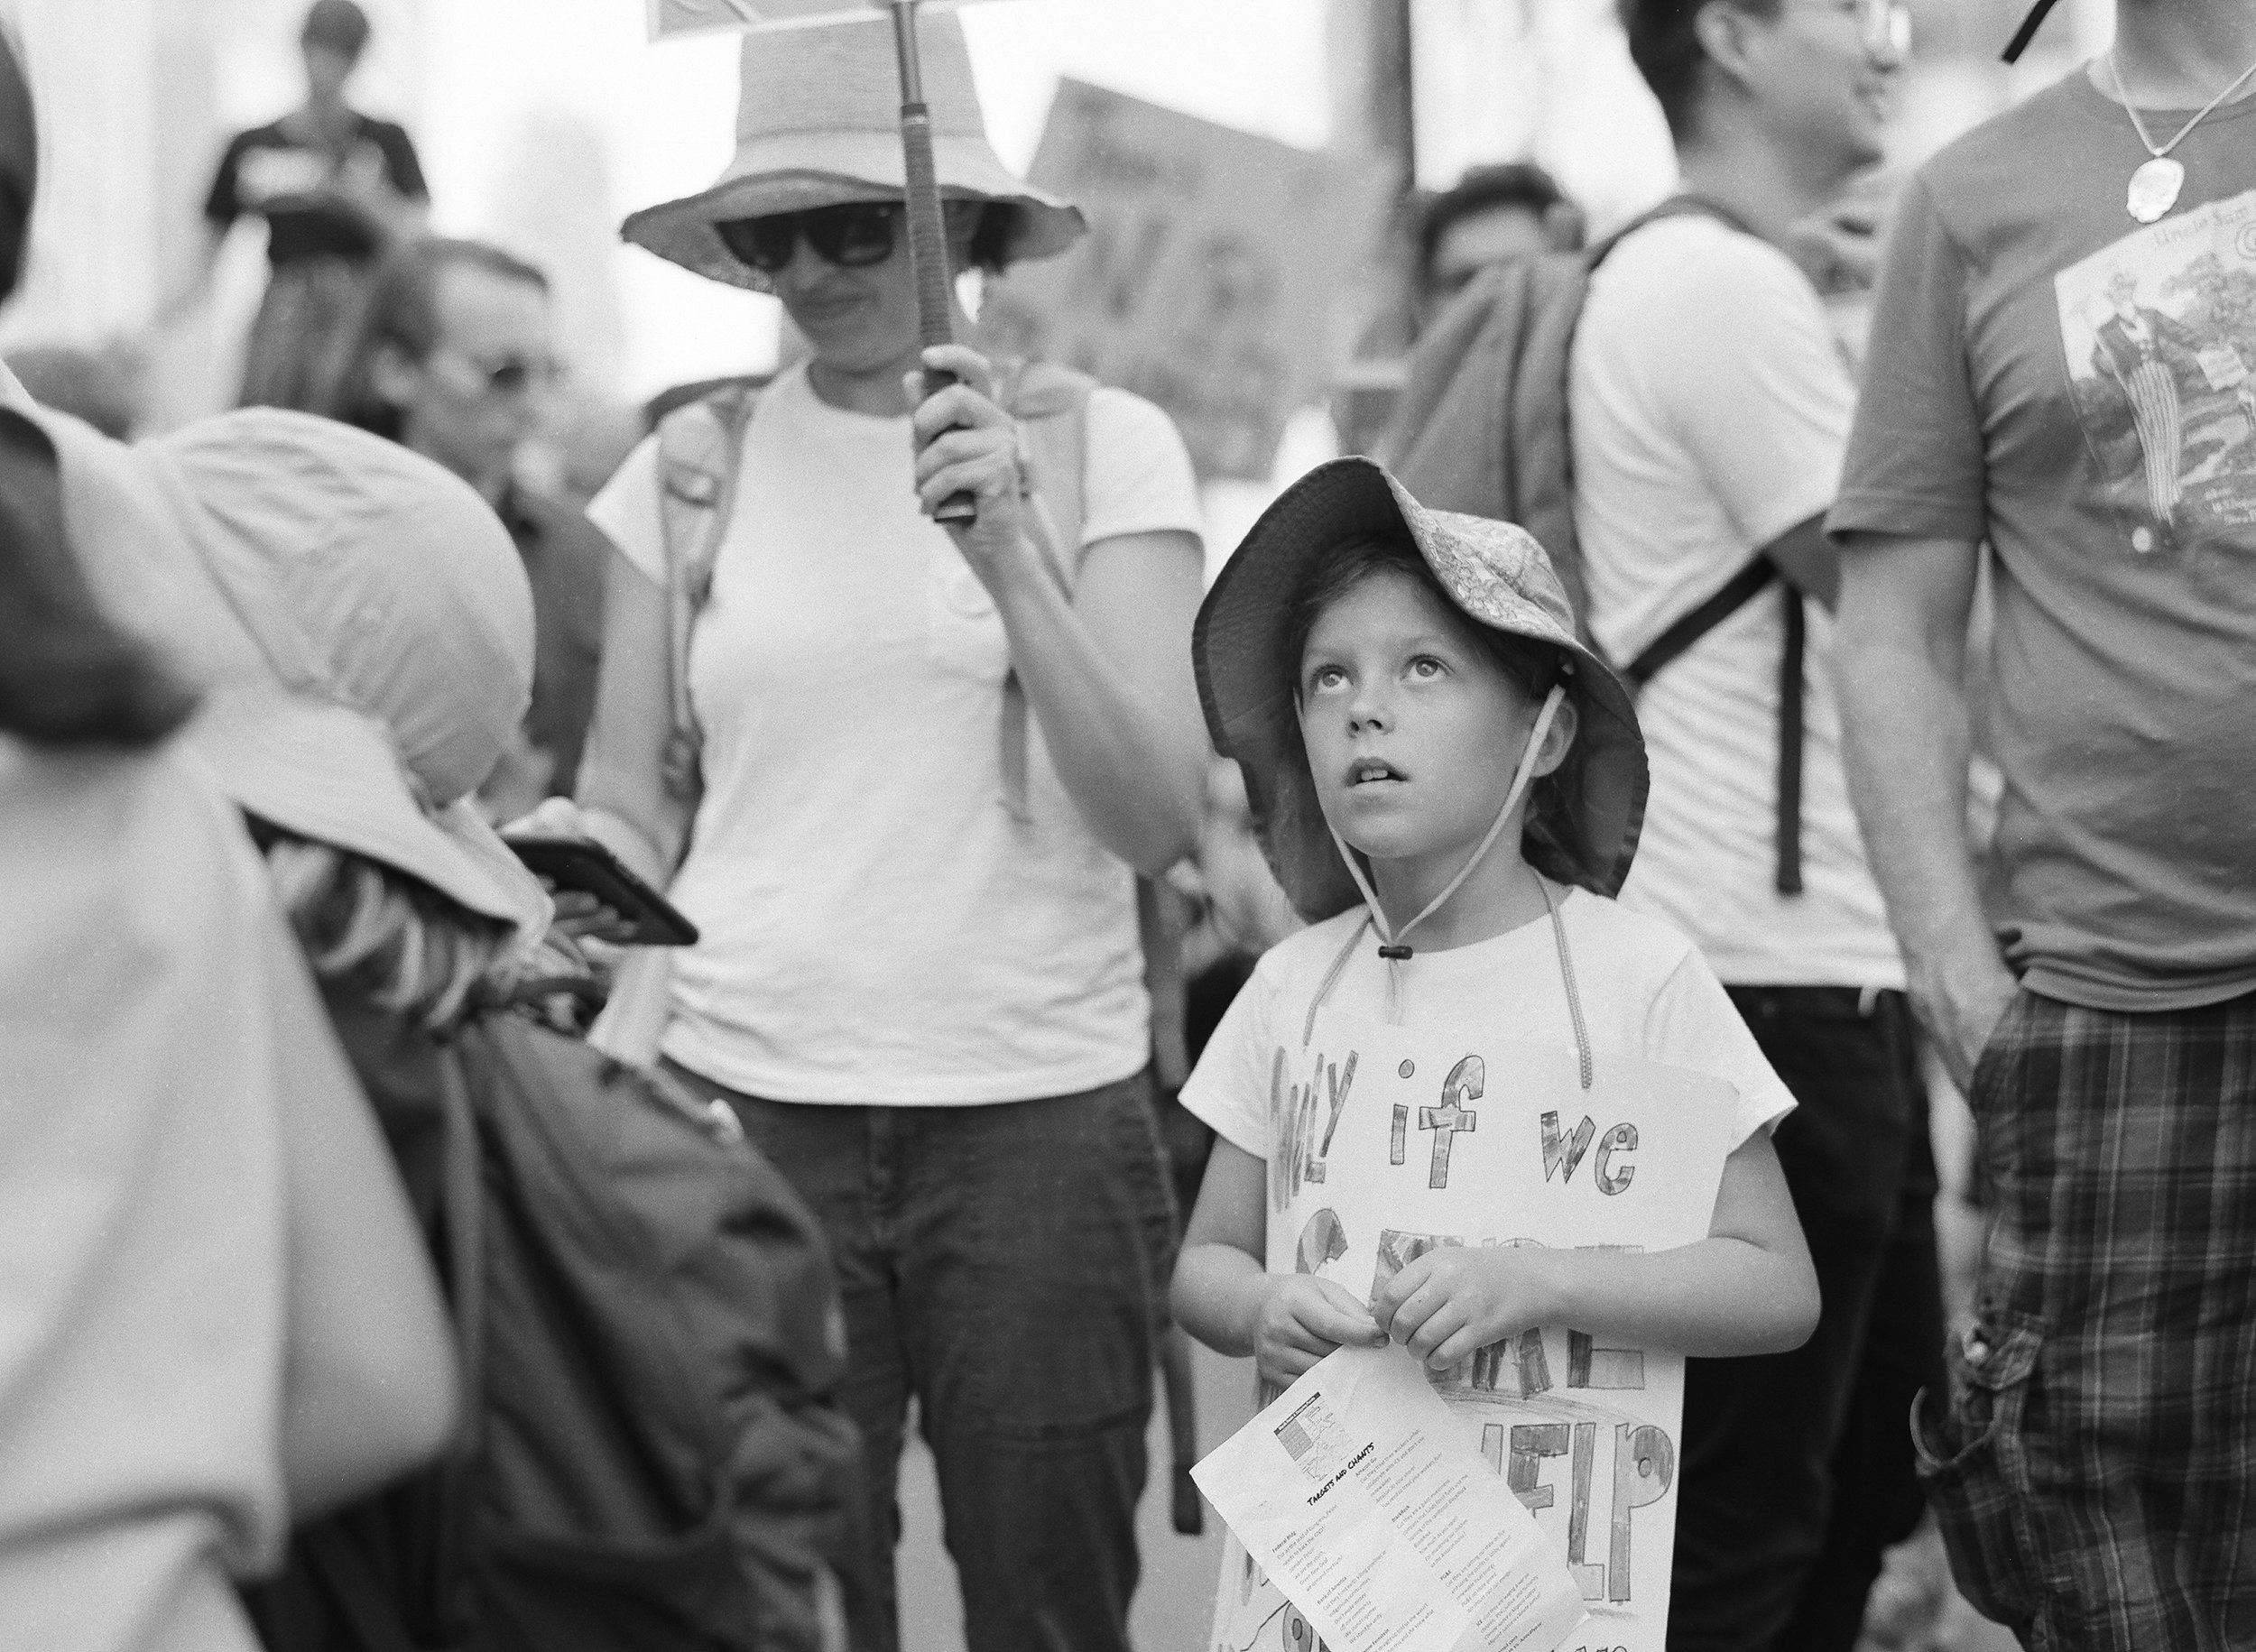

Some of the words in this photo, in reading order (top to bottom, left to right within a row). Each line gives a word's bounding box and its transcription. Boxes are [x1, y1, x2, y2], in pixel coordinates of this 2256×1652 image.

[1391, 1055, 1484, 1189] if
[1307, 1479, 1334, 1505] TARGETS
[1347, 1442, 1373, 1469] CHANTS
[1481, 1421, 1674, 1604] ELP
